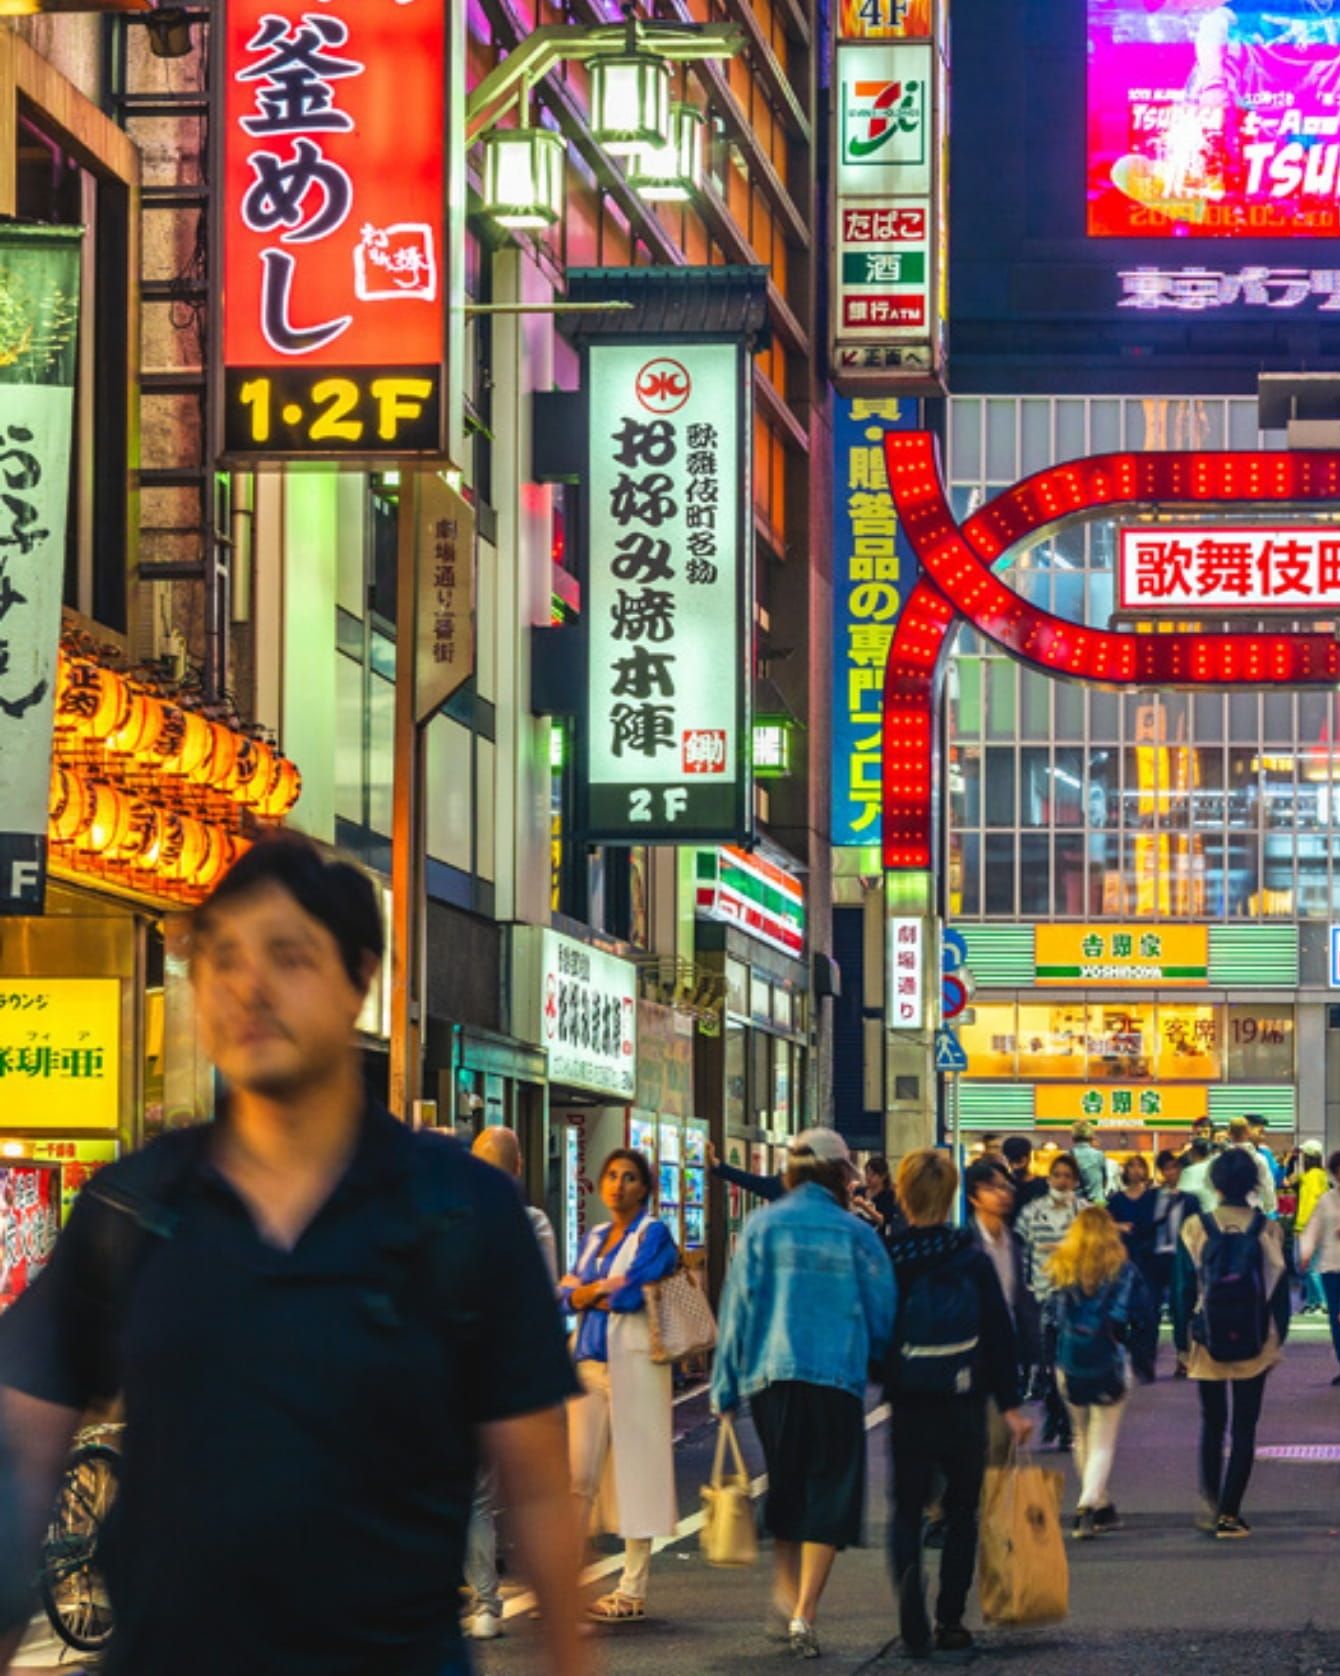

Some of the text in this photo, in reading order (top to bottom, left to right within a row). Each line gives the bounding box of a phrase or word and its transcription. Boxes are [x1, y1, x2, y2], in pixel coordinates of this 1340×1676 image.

[236, 14, 364, 354] 釜めし
[846, 211, 923, 240] たばこ
[866, 254, 902, 283] 酒
[847, 301, 921, 321] 銀行ATM
[686, 423, 718, 584] 歌舞伎町名物
[629, 787, 688, 822] 2F
[1082, 932, 1161, 957] 吉野家
[897, 925, 917, 1020] 劇場通り
[1082, 1091, 1161, 1115] 吉野家
